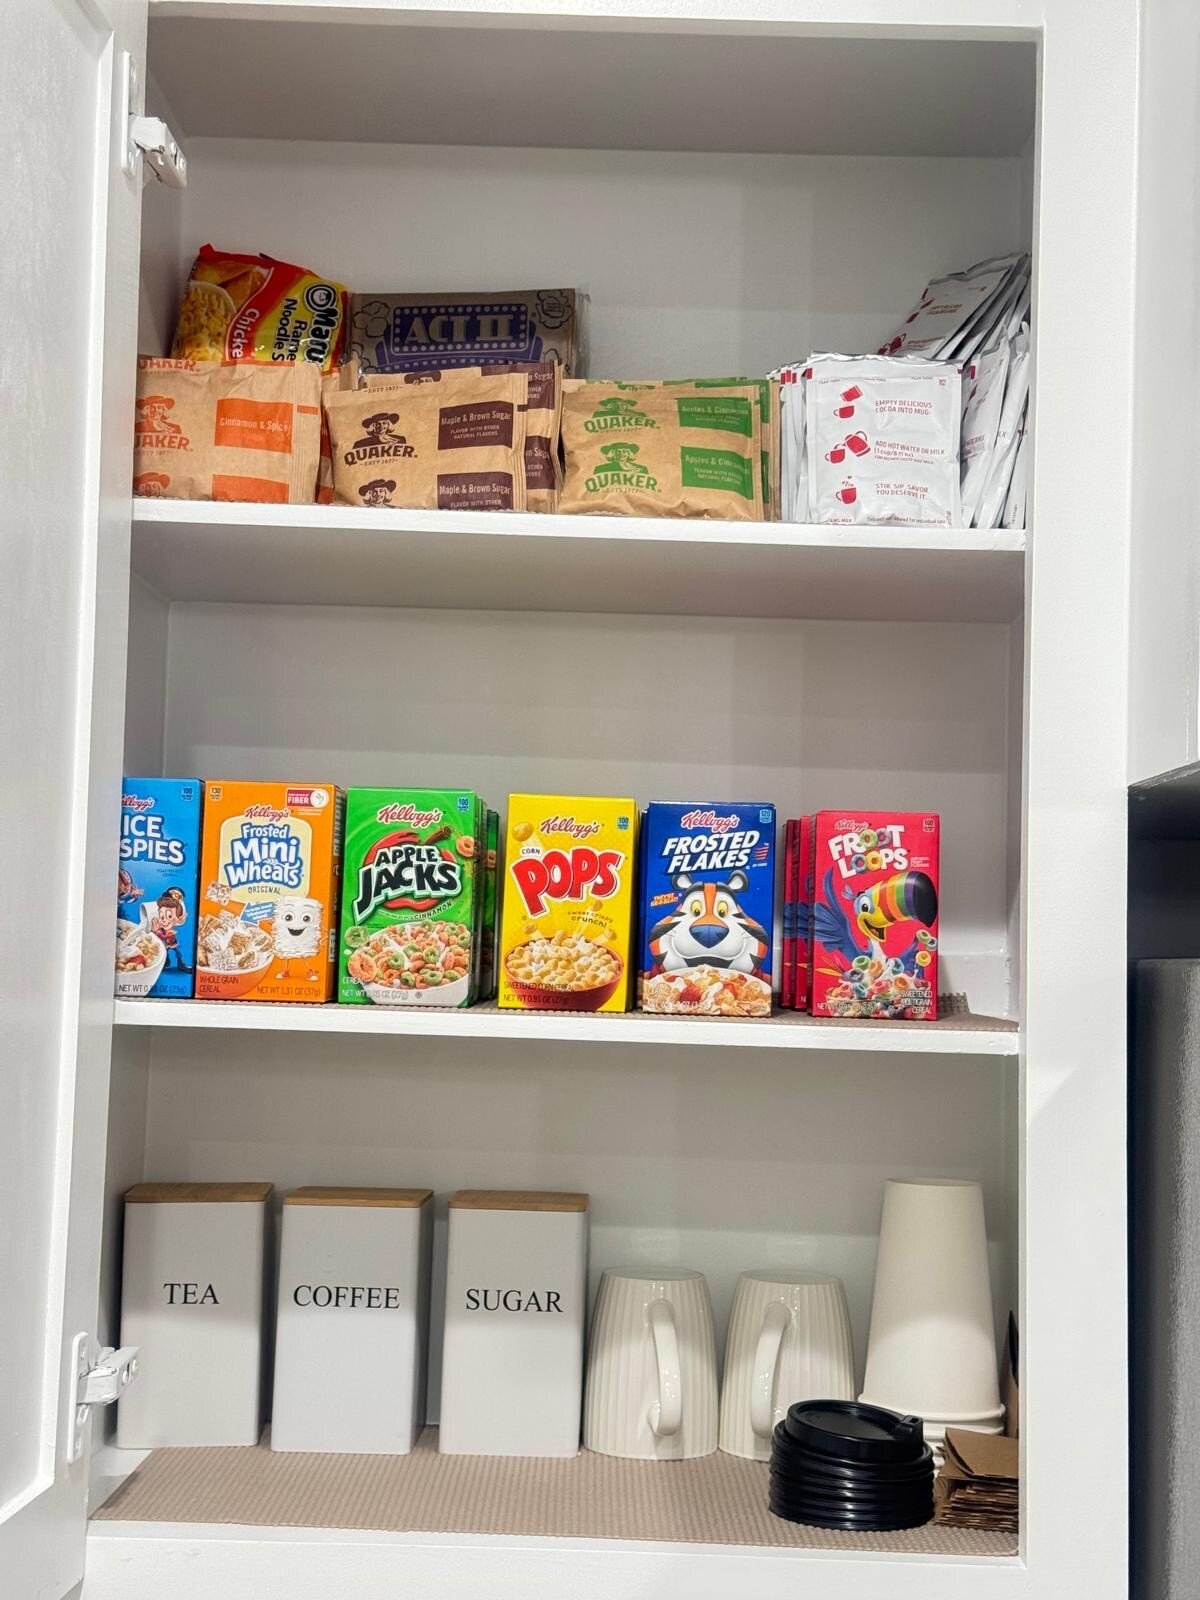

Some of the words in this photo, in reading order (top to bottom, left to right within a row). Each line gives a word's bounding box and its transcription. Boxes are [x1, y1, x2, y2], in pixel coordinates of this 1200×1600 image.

[232, 308, 260, 358] Chicke
[274, 299, 298, 349] Noodle
[405, 315, 471, 344] ACT
[476, 314, 514, 341] II
[899, 400, 932, 409] DELICIOUS
[220, 417, 257, 428] Cinnamon
[267, 421, 288, 432] Spice
[441, 416, 461, 425] Maple
[463, 414, 468, 422] &
[470, 412, 491, 421] Brown
[492, 410, 512, 421] Sugar
[584, 416, 656, 433] QUAKER
[875, 440, 887, 448] ADD
[900, 445, 920, 453] WATER
[685, 455, 709, 465] Apples
[440, 486, 460, 496] Maple
[462, 484, 467, 493] &
[469, 484, 491, 493] Brown
[492, 483, 511, 494] Sugar
[585, 473, 657, 493] QUAKER
[891, 490, 918, 499] DESERVE
[287, 796, 309, 804] FIBER
[246, 806, 290, 822] Kellogg's
[379, 804, 441, 827] Kellogg's
[682, 810, 739, 831] Kellogg's
[123, 815, 163, 838] ICE
[242, 824, 288, 838] Frosted
[540, 816, 600, 838] Kellogg's
[836, 819, 869, 832] Kellogg's
[233, 837, 297, 864] Mini
[662, 830, 760, 856] FROSTED
[828, 825, 904, 861] FROOT
[375, 846, 438, 867] APPLE
[668, 849, 750, 874] FLAKES
[838, 848, 908, 879] LOOPS
[226, 860, 300, 887] Wheats
[511, 848, 621, 917] POPS
[248, 886, 281, 895] ORIGINAL
[357, 864, 460, 915] JACKS
[415, 900, 452, 920] CINNAMON
[571, 916, 607, 929] crunch!
[159, 985, 168, 993] OZ
[200, 976, 220, 984] WHOLE
[221, 976, 239, 985] GRAIN
[200, 985, 220, 993] CEREAL
[257, 986, 269, 994] NET
[270, 986, 280, 994] WT
[282, 987, 293, 995] 1.31
[295, 987, 304, 995] OZ
[304, 987, 321, 996] (37g)
[343, 989, 354, 997] NET
[355, 989, 365, 997] WT
[504, 994, 515, 1002] NET
[516, 994, 527, 1002] WT
[163, 1283, 220, 1305] TEA
[293, 1285, 400, 1310] COFFEE
[465, 1289, 564, 1313] SUGAR
